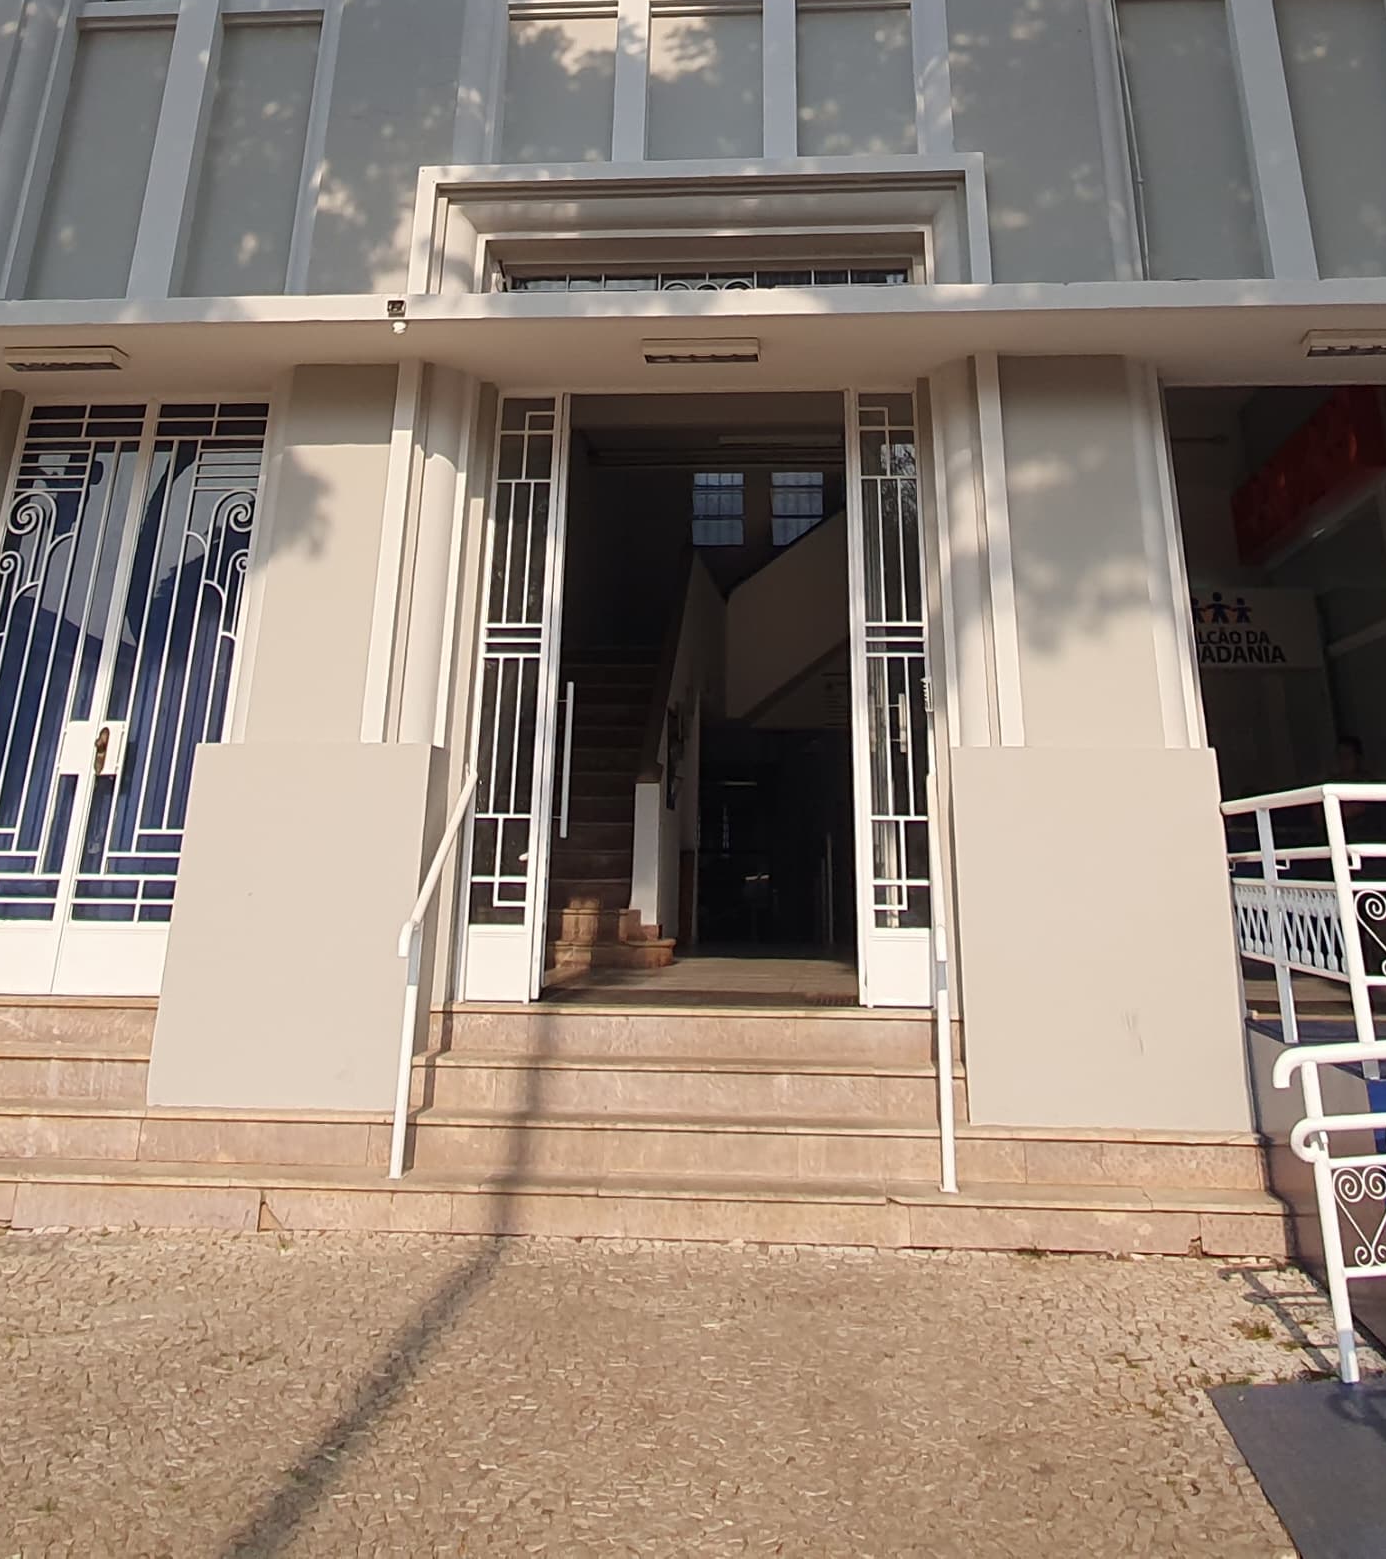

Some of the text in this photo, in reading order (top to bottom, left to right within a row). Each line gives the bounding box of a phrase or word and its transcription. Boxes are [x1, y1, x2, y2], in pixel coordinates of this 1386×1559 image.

[1196, 627, 1271, 644] LCÃO DA
[1196, 645, 1286, 663] ADANIA
